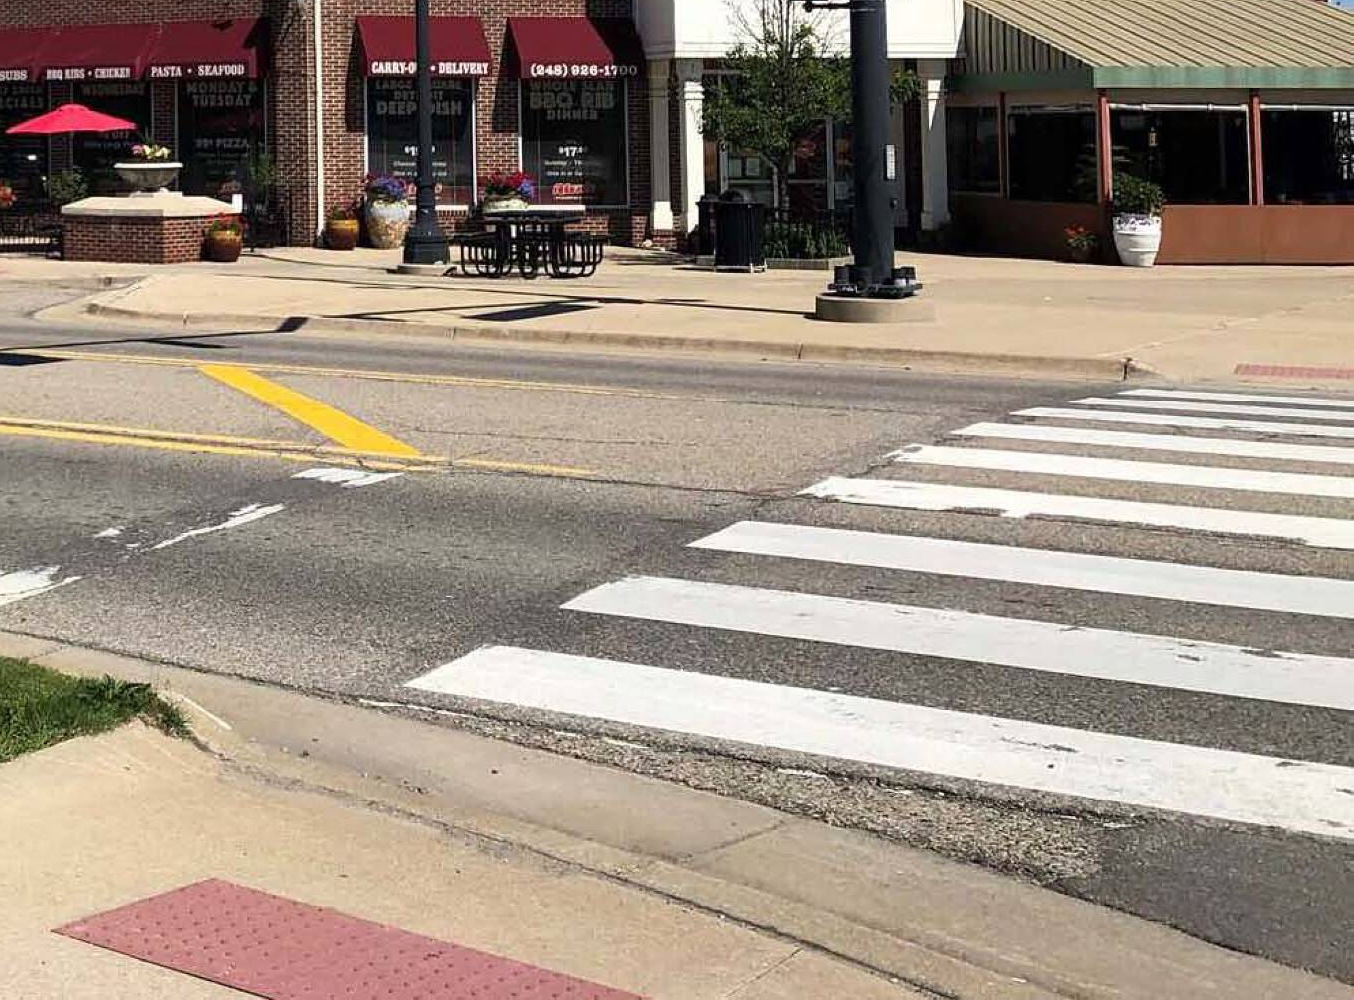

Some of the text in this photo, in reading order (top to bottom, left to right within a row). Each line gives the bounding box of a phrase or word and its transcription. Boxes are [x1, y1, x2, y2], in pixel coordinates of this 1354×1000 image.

[94, 67, 131, 79] CHICKEN
[151, 64, 245, 78] PASTA SEAFOOD
[371, 61, 488, 75] CARRY-O DELIVERY
[530, 63, 638, 77] (248) 926-1700
